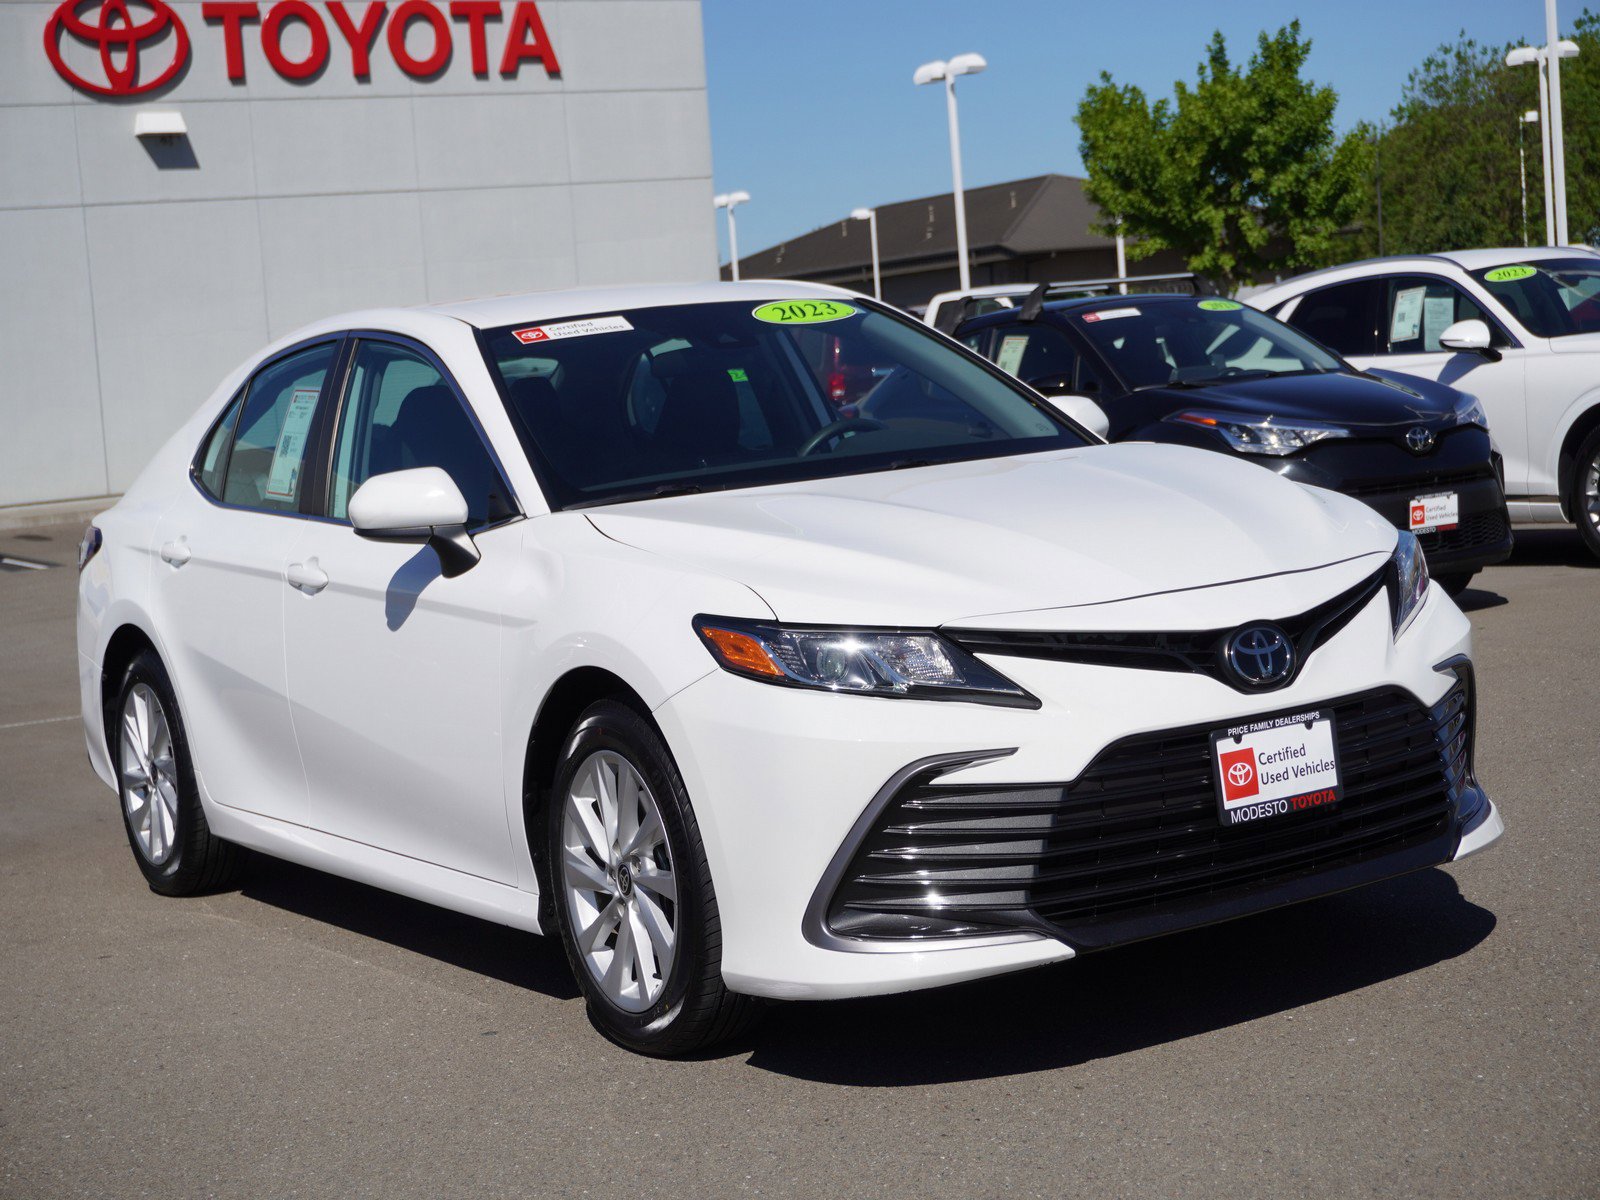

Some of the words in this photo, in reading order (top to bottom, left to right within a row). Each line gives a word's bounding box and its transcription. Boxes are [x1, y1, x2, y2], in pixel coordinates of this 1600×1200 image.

[202, 0, 561, 81] TOYOTA
[772, 302, 838, 321] 2023
[548, 321, 594, 332] Certified
[553, 329, 579, 337] Used
[580, 324, 625, 334] Vehicles
[1425, 504, 1447, 513] Certified
[1227, 725, 1249, 736] PRICE
[1250, 719, 1274, 732] FAMILY
[1275, 711, 1320, 727] DEALERSHIPS
[1258, 743, 1307, 766] Certified
[1260, 767, 1289, 785] Used
[1291, 758, 1335, 777] Vehicles
[1230, 799, 1288, 824] MODESTO
[1290, 789, 1336, 810] TOYOTA
